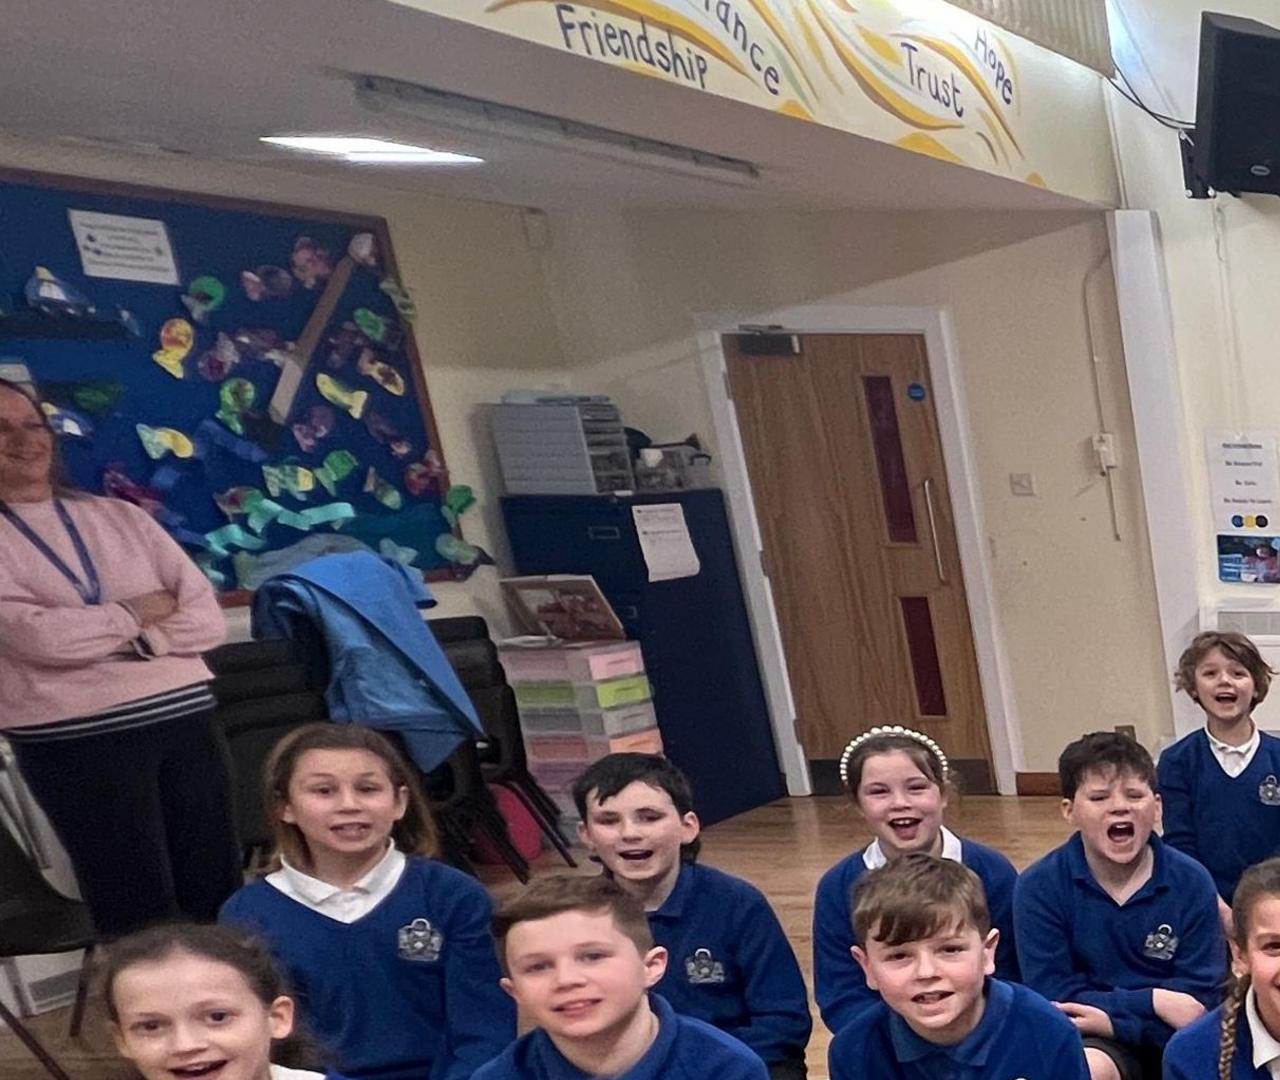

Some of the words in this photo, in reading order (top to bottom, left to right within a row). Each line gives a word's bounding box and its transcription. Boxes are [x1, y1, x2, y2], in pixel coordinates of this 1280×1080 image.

[555, 4, 708, 89] Friendship
[900, 41, 964, 118] Trust
[974, 26, 1013, 105] Hope
